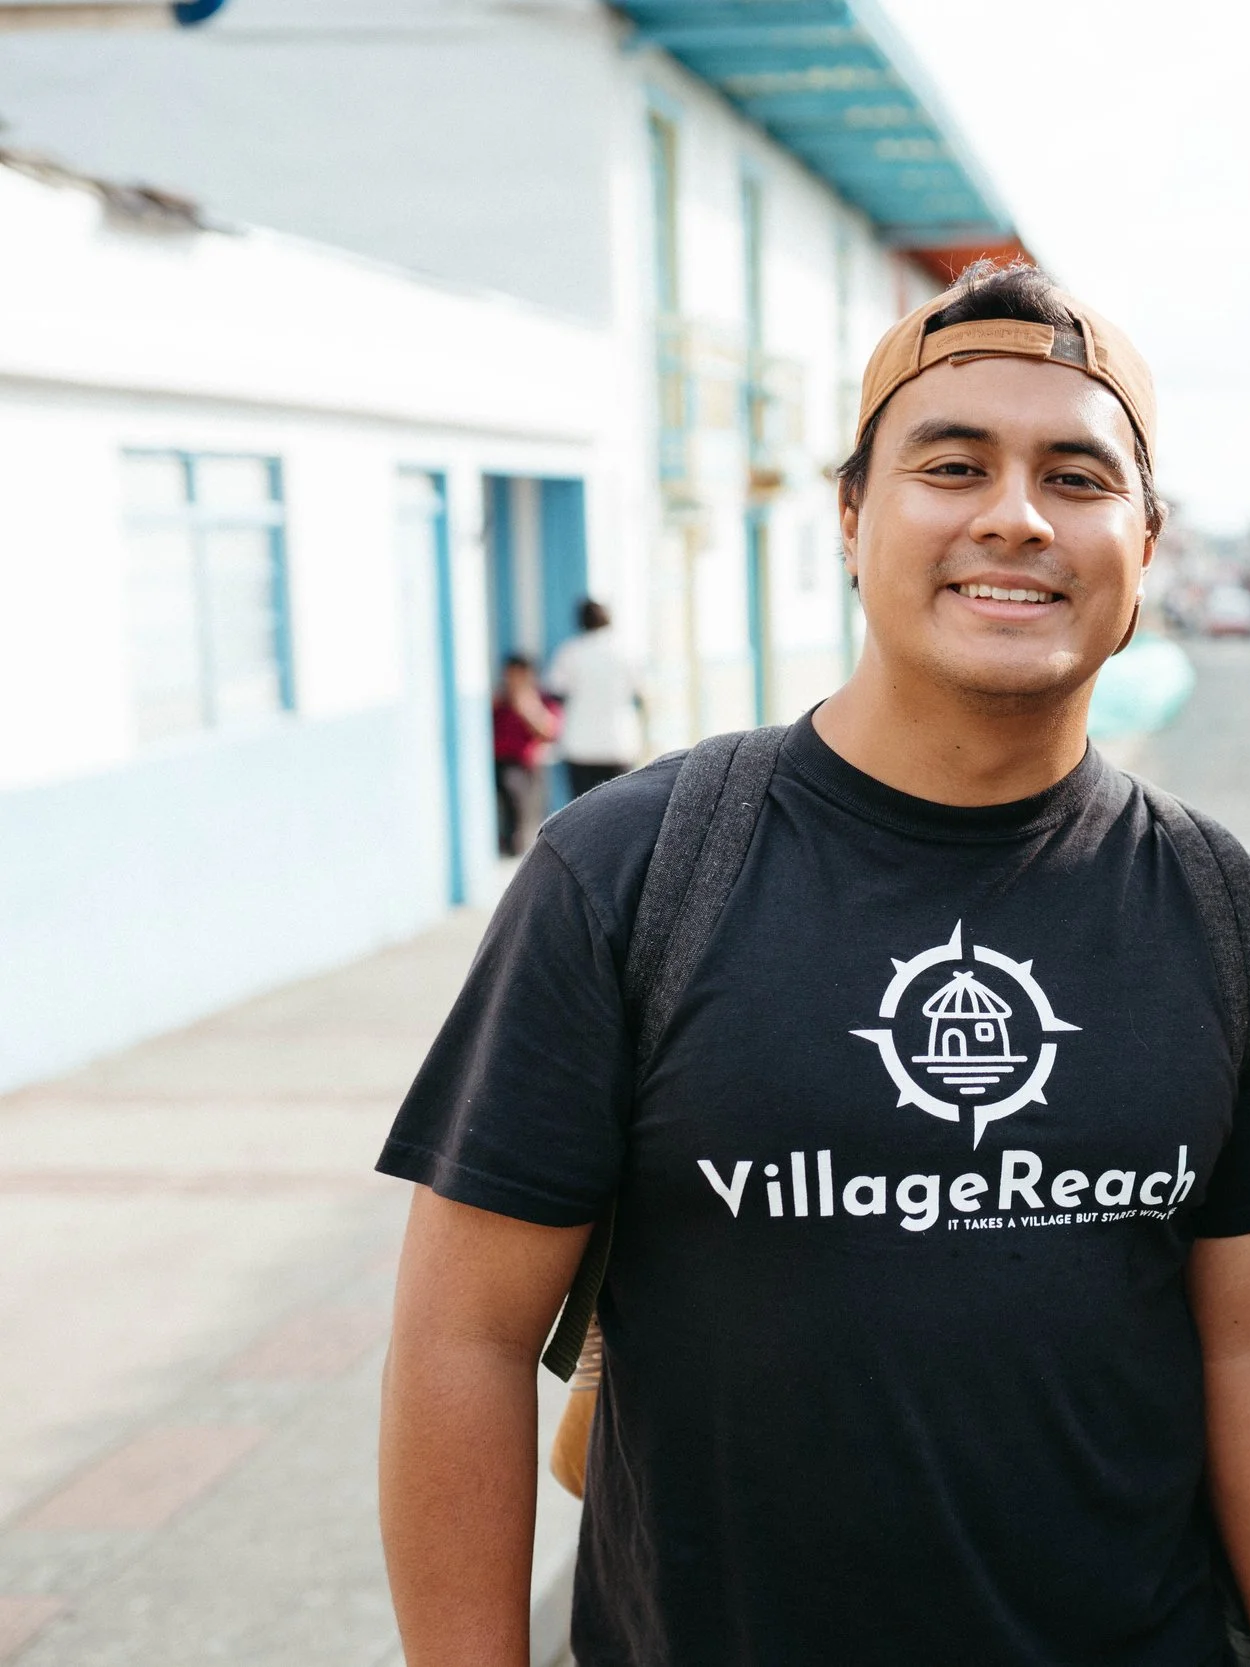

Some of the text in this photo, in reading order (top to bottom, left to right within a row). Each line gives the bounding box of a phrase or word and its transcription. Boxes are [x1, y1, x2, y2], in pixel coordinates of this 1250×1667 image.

[696, 1144, 1196, 1232] VillageReach
[947, 1219, 960, 1231] IT
[963, 1217, 1004, 1230] TAKES
[1007, 1217, 1016, 1229] A
[1020, 1213, 1073, 1228] VILLAGE
[1075, 1212, 1099, 1224] BUT
[1100, 1209, 1138, 1223] STARTS
[1139, 1209, 1167, 1221] WITH
